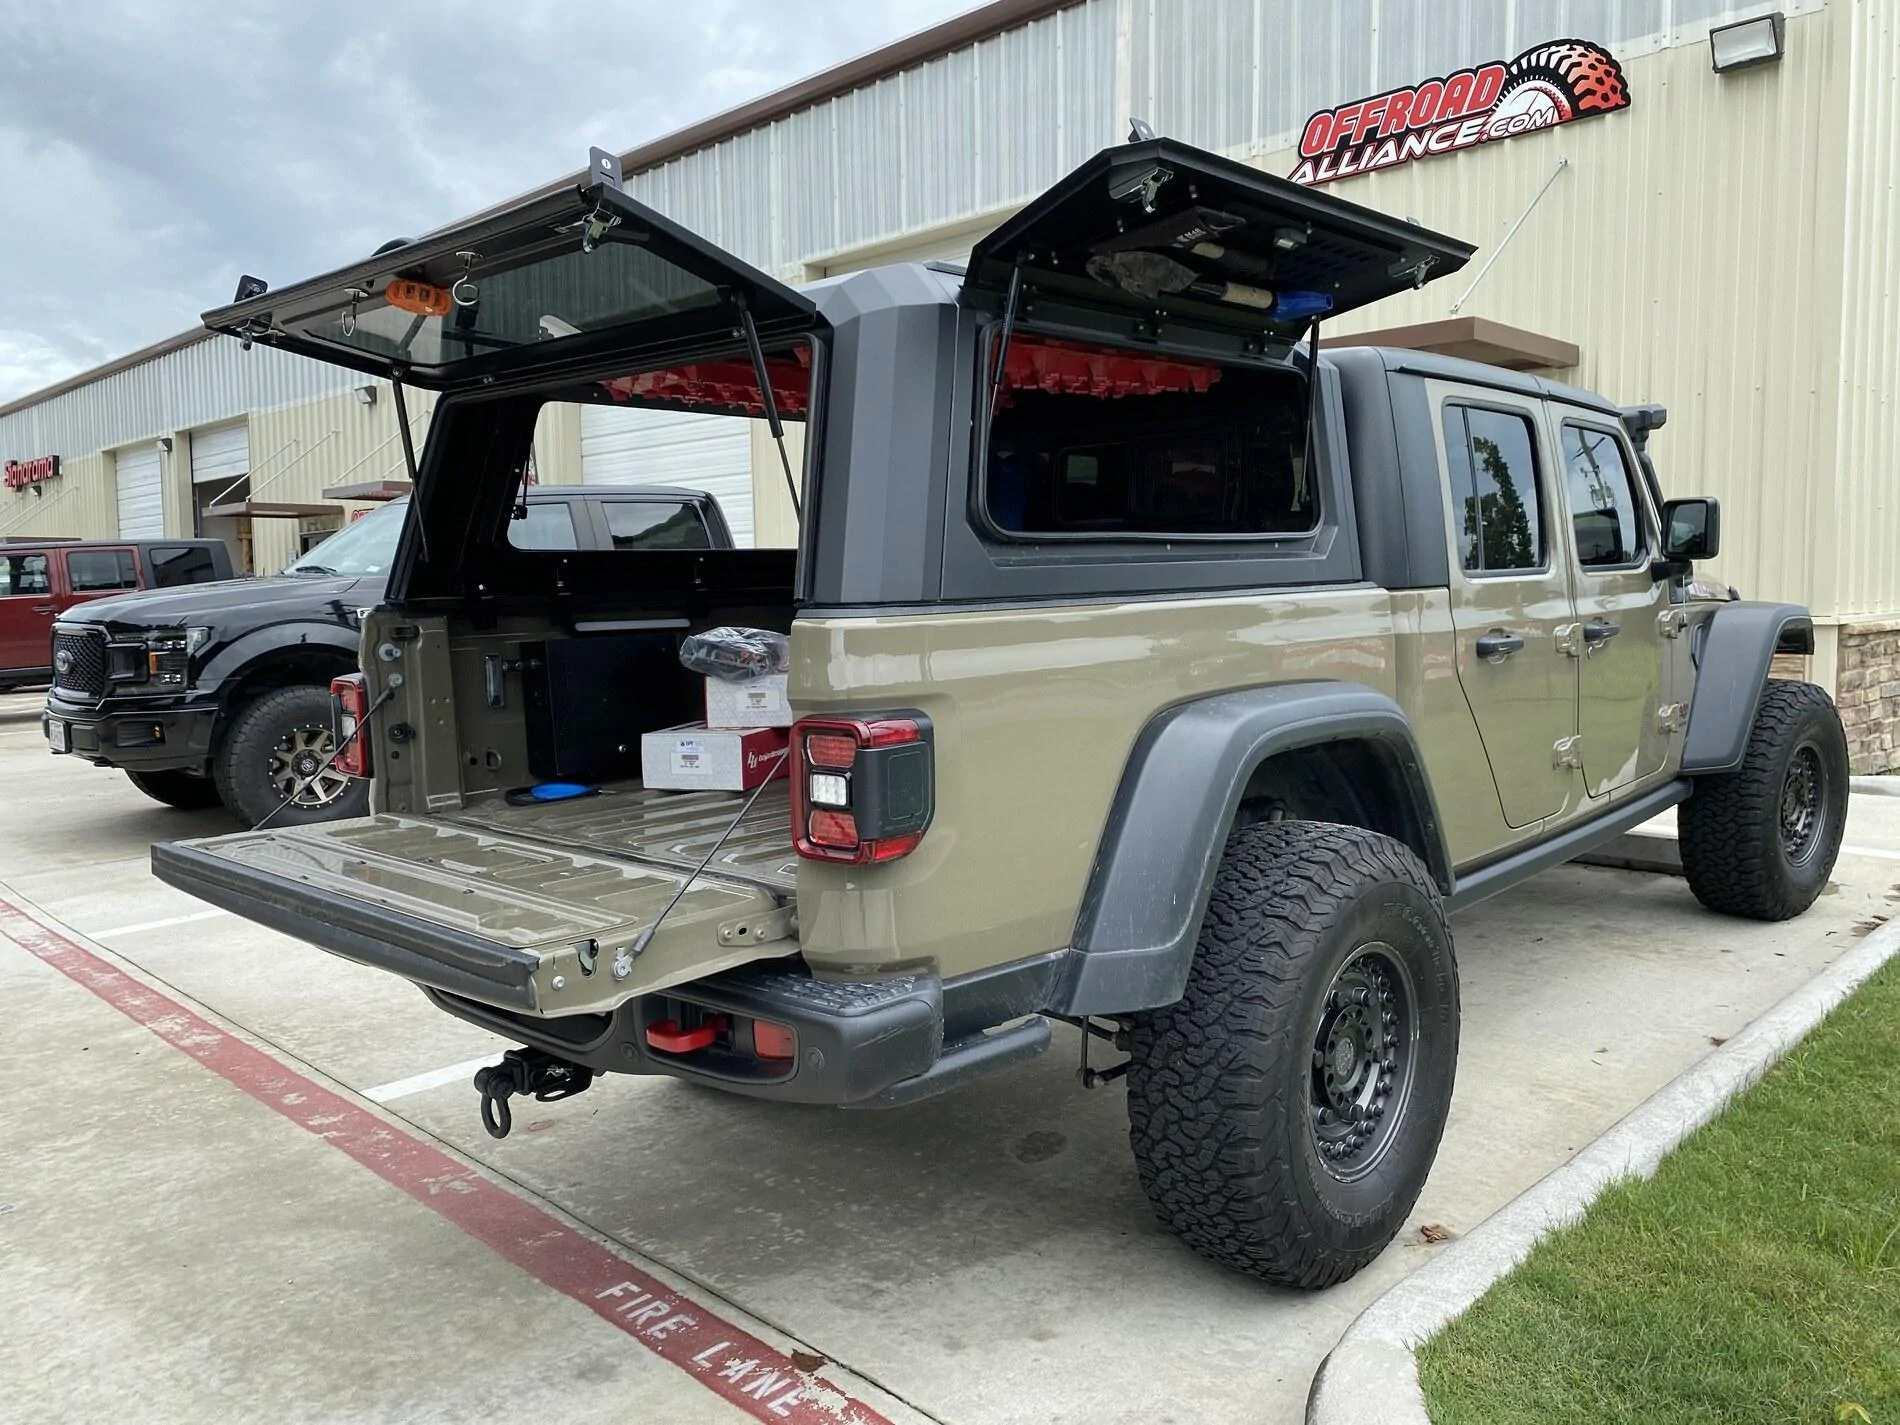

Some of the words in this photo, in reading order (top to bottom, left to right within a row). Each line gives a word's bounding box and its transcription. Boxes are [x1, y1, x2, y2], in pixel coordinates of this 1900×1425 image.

[1302, 66, 1506, 157] OFFROAD
[4, 456, 53, 489] Signarama
[595, 1281, 698, 1340] FIRE
[690, 1341, 803, 1417] LANE
